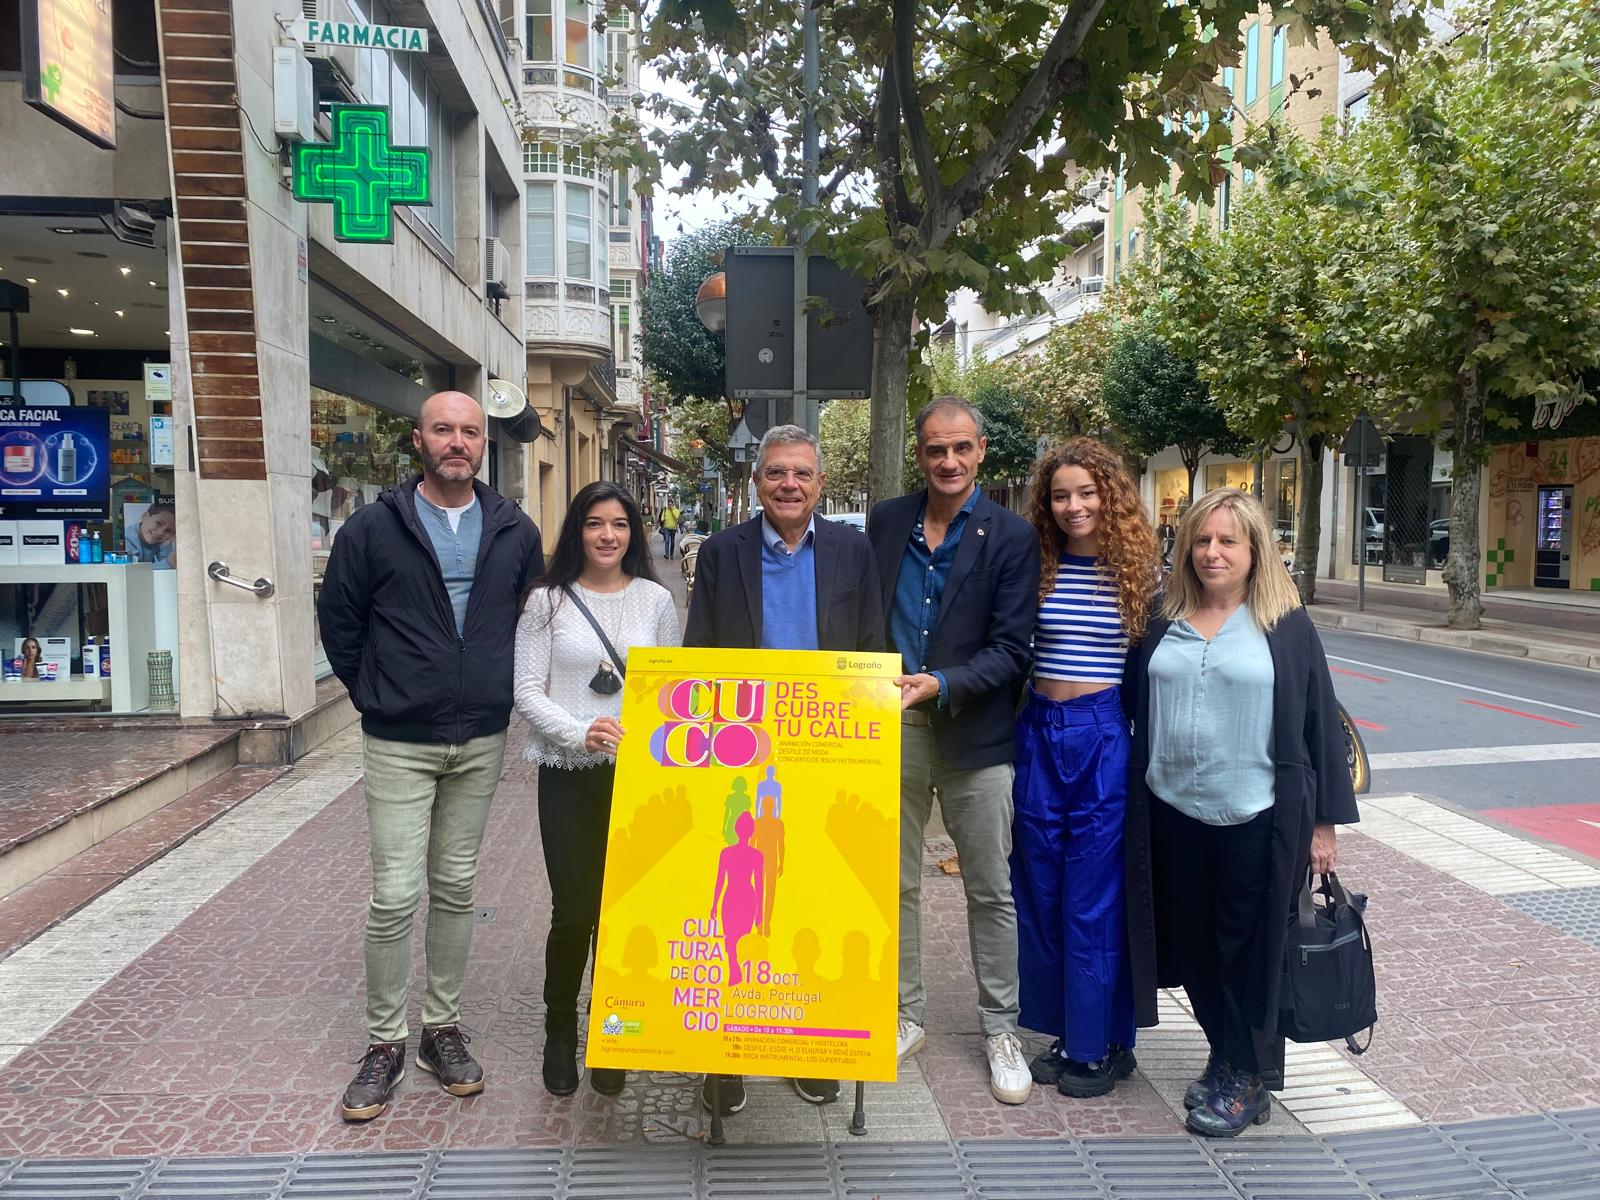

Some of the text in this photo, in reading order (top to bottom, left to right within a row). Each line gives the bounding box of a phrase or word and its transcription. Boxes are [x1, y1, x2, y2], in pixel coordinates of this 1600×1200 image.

[308, 21, 422, 50] FARMACIA
[19, 409, 61, 421] FACIAL
[24, 536, 57, 545] Neutrogena
[70, 526, 80, 560] 20%
[848, 661, 882, 670] Logroño
[670, 678, 763, 722] CU
[776, 682, 818, 699] DES
[774, 700, 850, 719] CUBRE
[774, 719, 881, 739] TU CALLE
[665, 722, 759, 767] CO
[683, 918, 725, 939] CUL
[667, 940, 723, 961] TURA
[670, 964, 722, 985] DE CO
[742, 959, 803, 987] 18 OCT.
[605, 995, 645, 1008] Cámara
[673, 987, 721, 1008] MER
[732, 987, 822, 1005] Avda. Portugal
[684, 1011, 719, 1032] CIO
[724, 1003, 804, 1021] LOGROÑO
[777, 1038, 808, 1046] COMERCIAL
